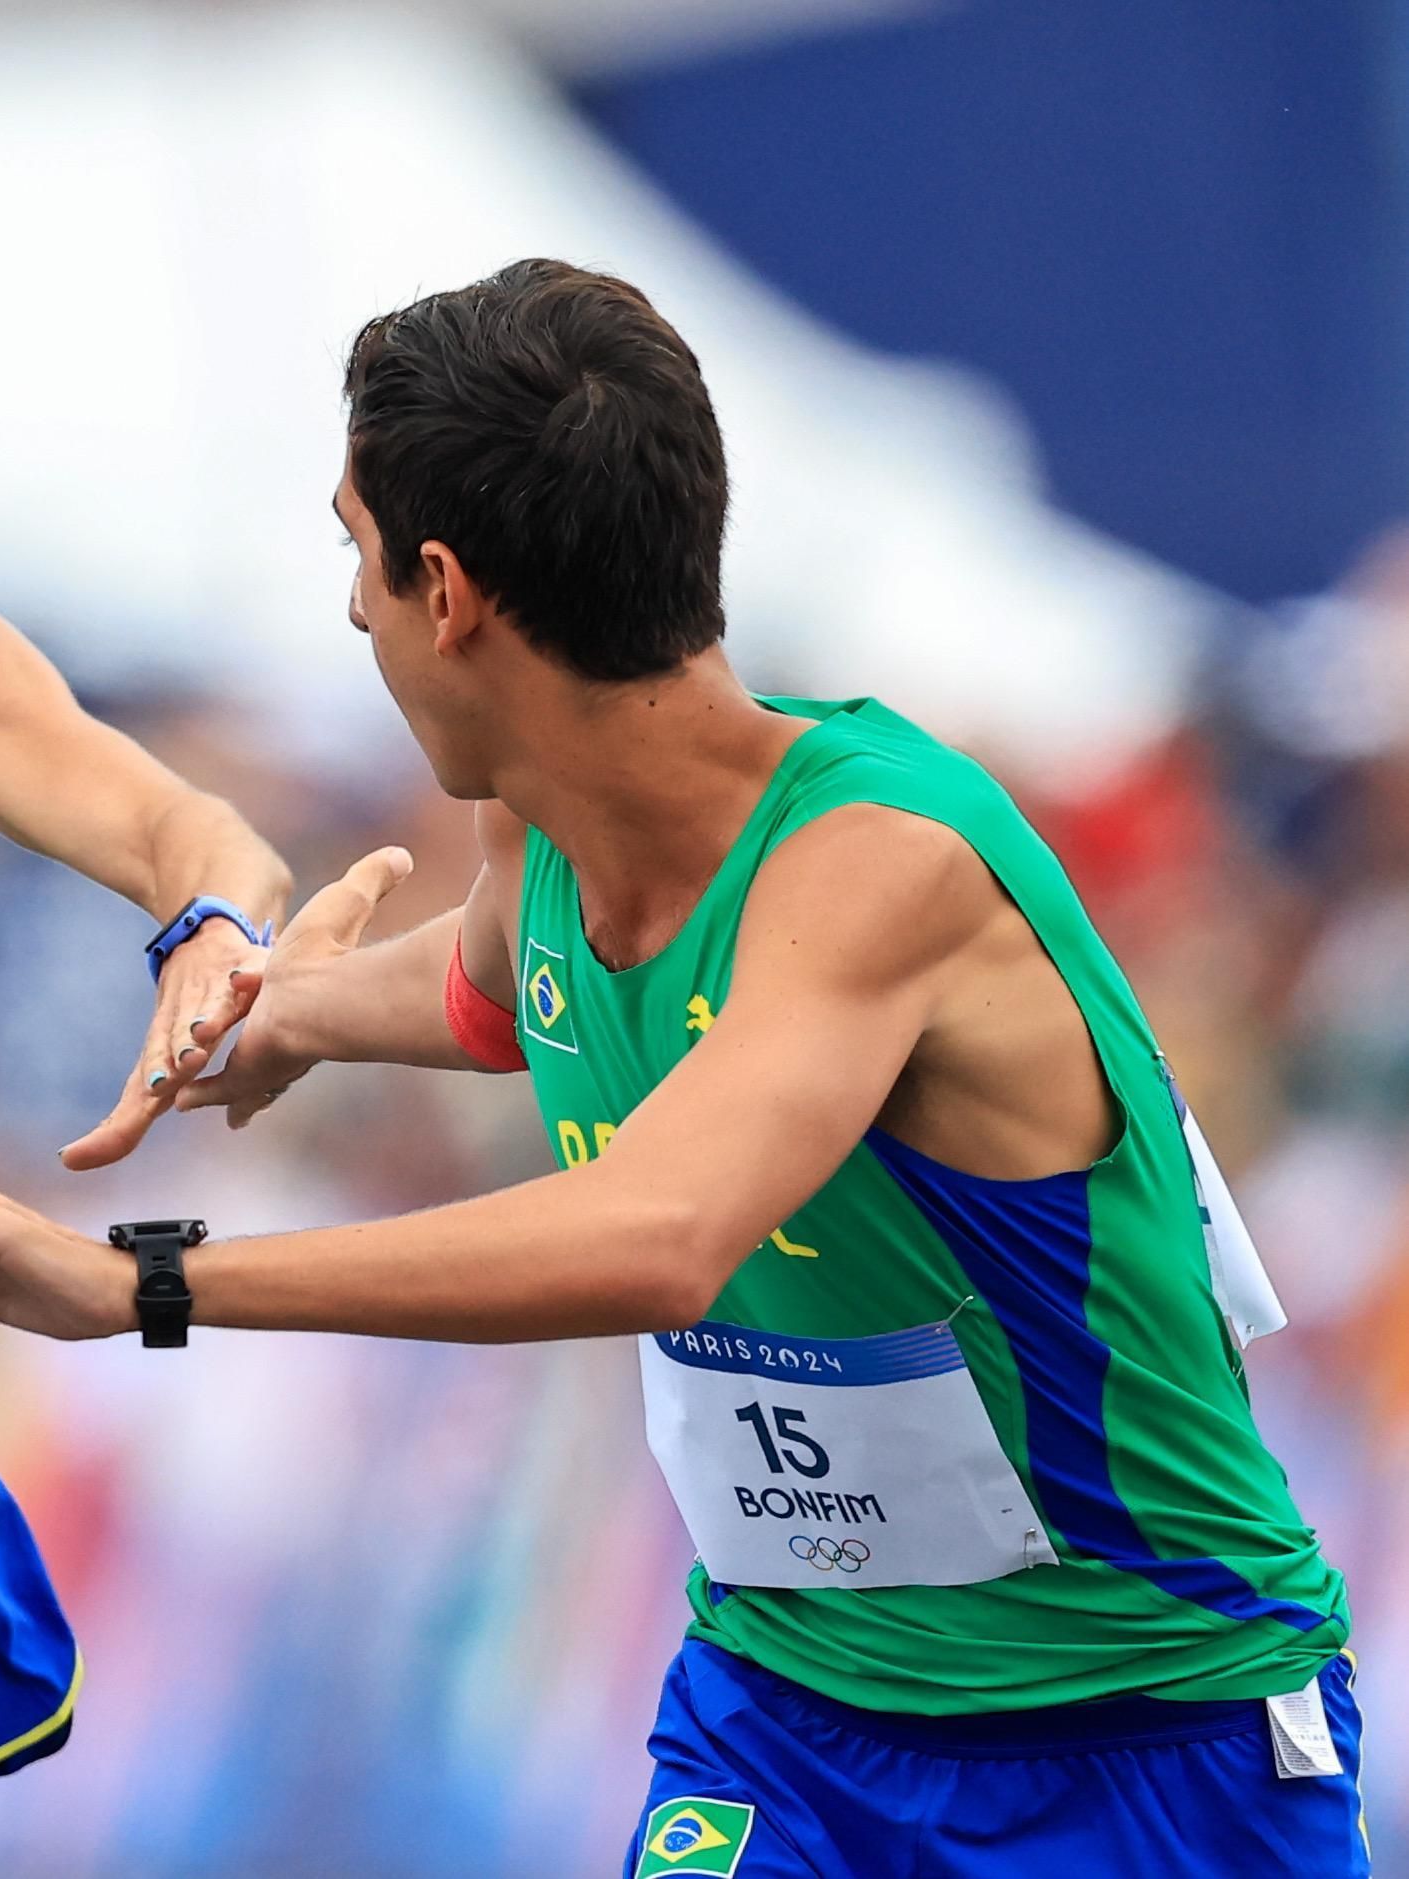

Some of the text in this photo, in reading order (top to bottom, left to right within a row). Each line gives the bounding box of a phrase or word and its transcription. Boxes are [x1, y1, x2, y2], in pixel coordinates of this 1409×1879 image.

[758, 1344, 843, 1373] 2024
[734, 1400, 831, 1480] 15
[733, 1486, 889, 1525] BONFIM
